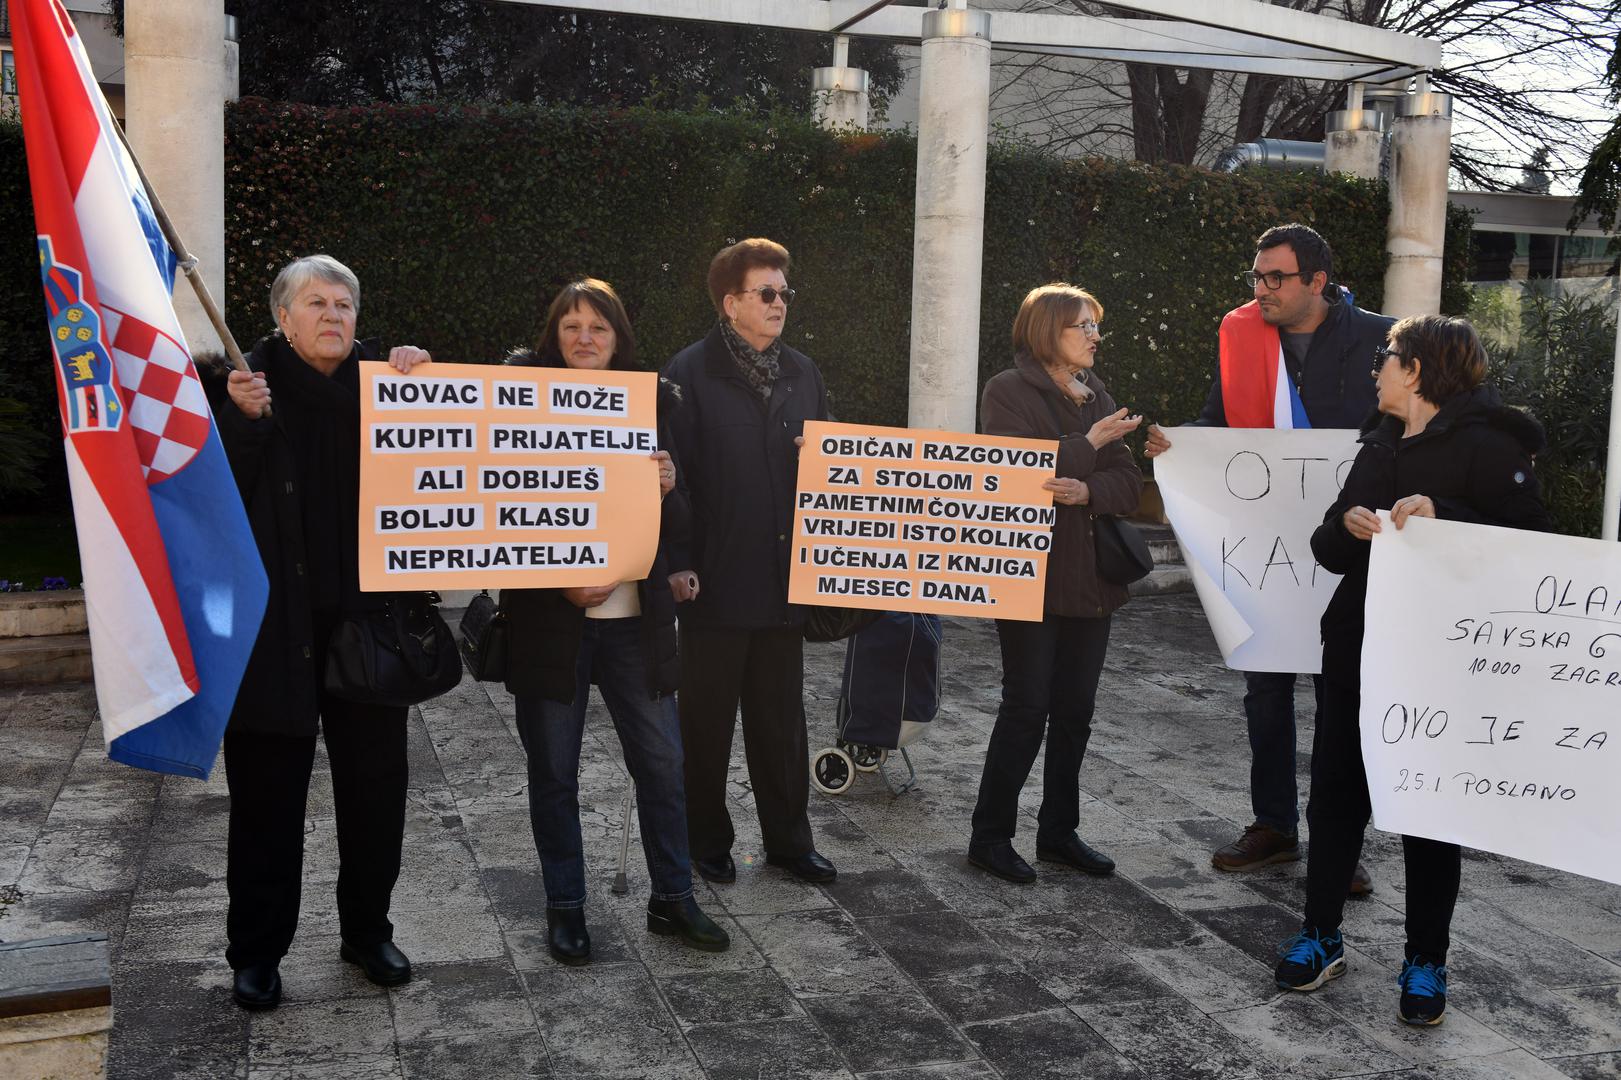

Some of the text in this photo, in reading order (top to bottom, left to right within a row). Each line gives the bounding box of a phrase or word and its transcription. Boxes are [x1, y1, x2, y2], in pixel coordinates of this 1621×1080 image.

[378, 383, 624, 412] NOVAC NE MOŽE
[375, 428, 657, 453] KUPITI PRIJATELJE,
[822, 437, 1054, 468] OBIČAN RAZGOVOR
[418, 468, 599, 490] ALI DOBIJEŠ
[828, 467, 998, 492] ZA STOLOM S
[380, 507, 589, 530] BOLJU KLASU
[799, 492, 1054, 525] PAMETNIM ČOVJEKOM
[804, 518, 1050, 551] VRIJEDI ISTO KOLIKO
[388, 545, 605, 570] NEPRIJATELJA.
[800, 546, 1035, 577] I UČENJA IZ KNJIGA
[818, 577, 996, 604] MJESEC DANA.
[1469, 658, 1521, 675] 10.000
[1465, 717, 1524, 744] JE
[1555, 727, 1607, 749] ZA
[1453, 772, 1576, 800] POSLANO
